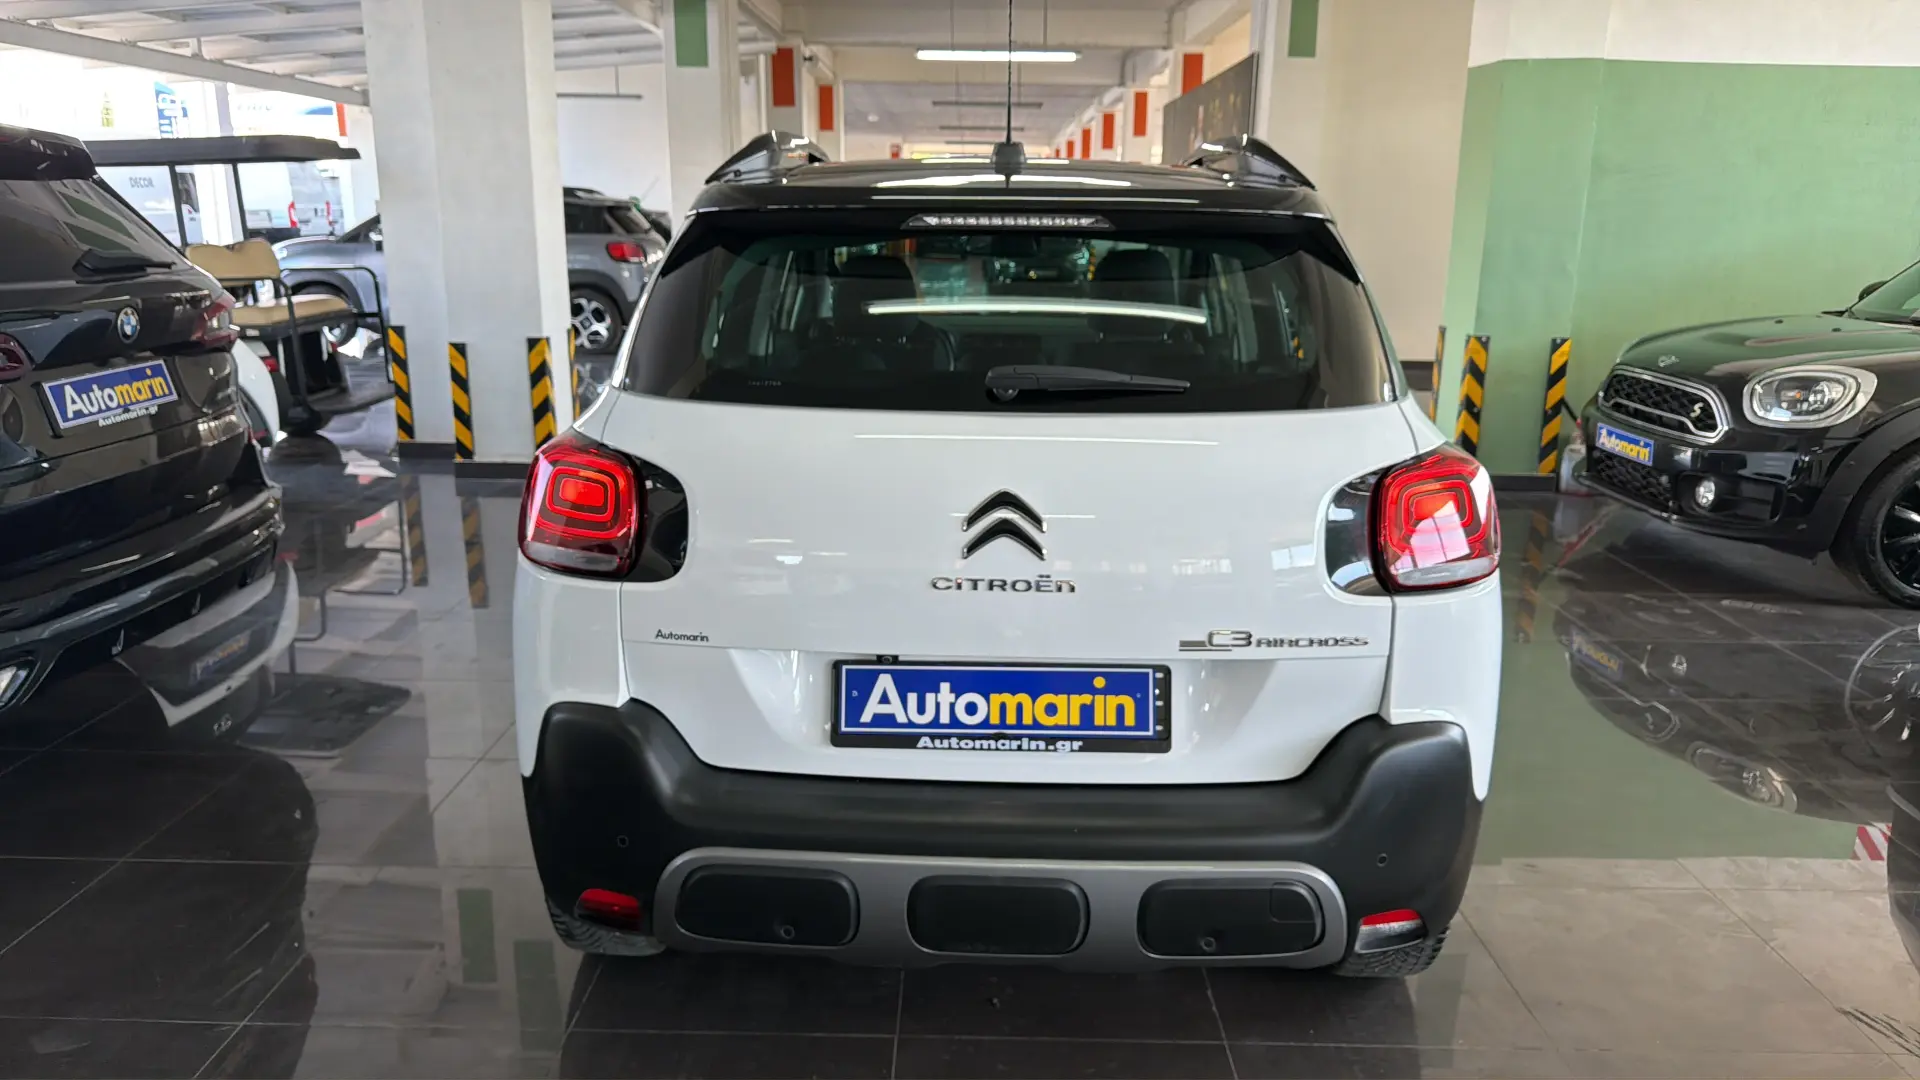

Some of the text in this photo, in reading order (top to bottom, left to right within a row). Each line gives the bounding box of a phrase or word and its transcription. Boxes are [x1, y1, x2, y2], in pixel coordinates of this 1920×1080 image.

[128, 176, 155, 189] DECOR
[64, 368, 169, 419] Automarin
[98, 405, 159, 427] Automarin.gr
[1600, 427, 1650, 461] Automarin
[655, 628, 709, 642] Automarin
[1207, 629, 1369, 648] C3 AIRCROSS
[859, 673, 1135, 726] Automarin
[916, 735, 1083, 753] Automarin.gr
